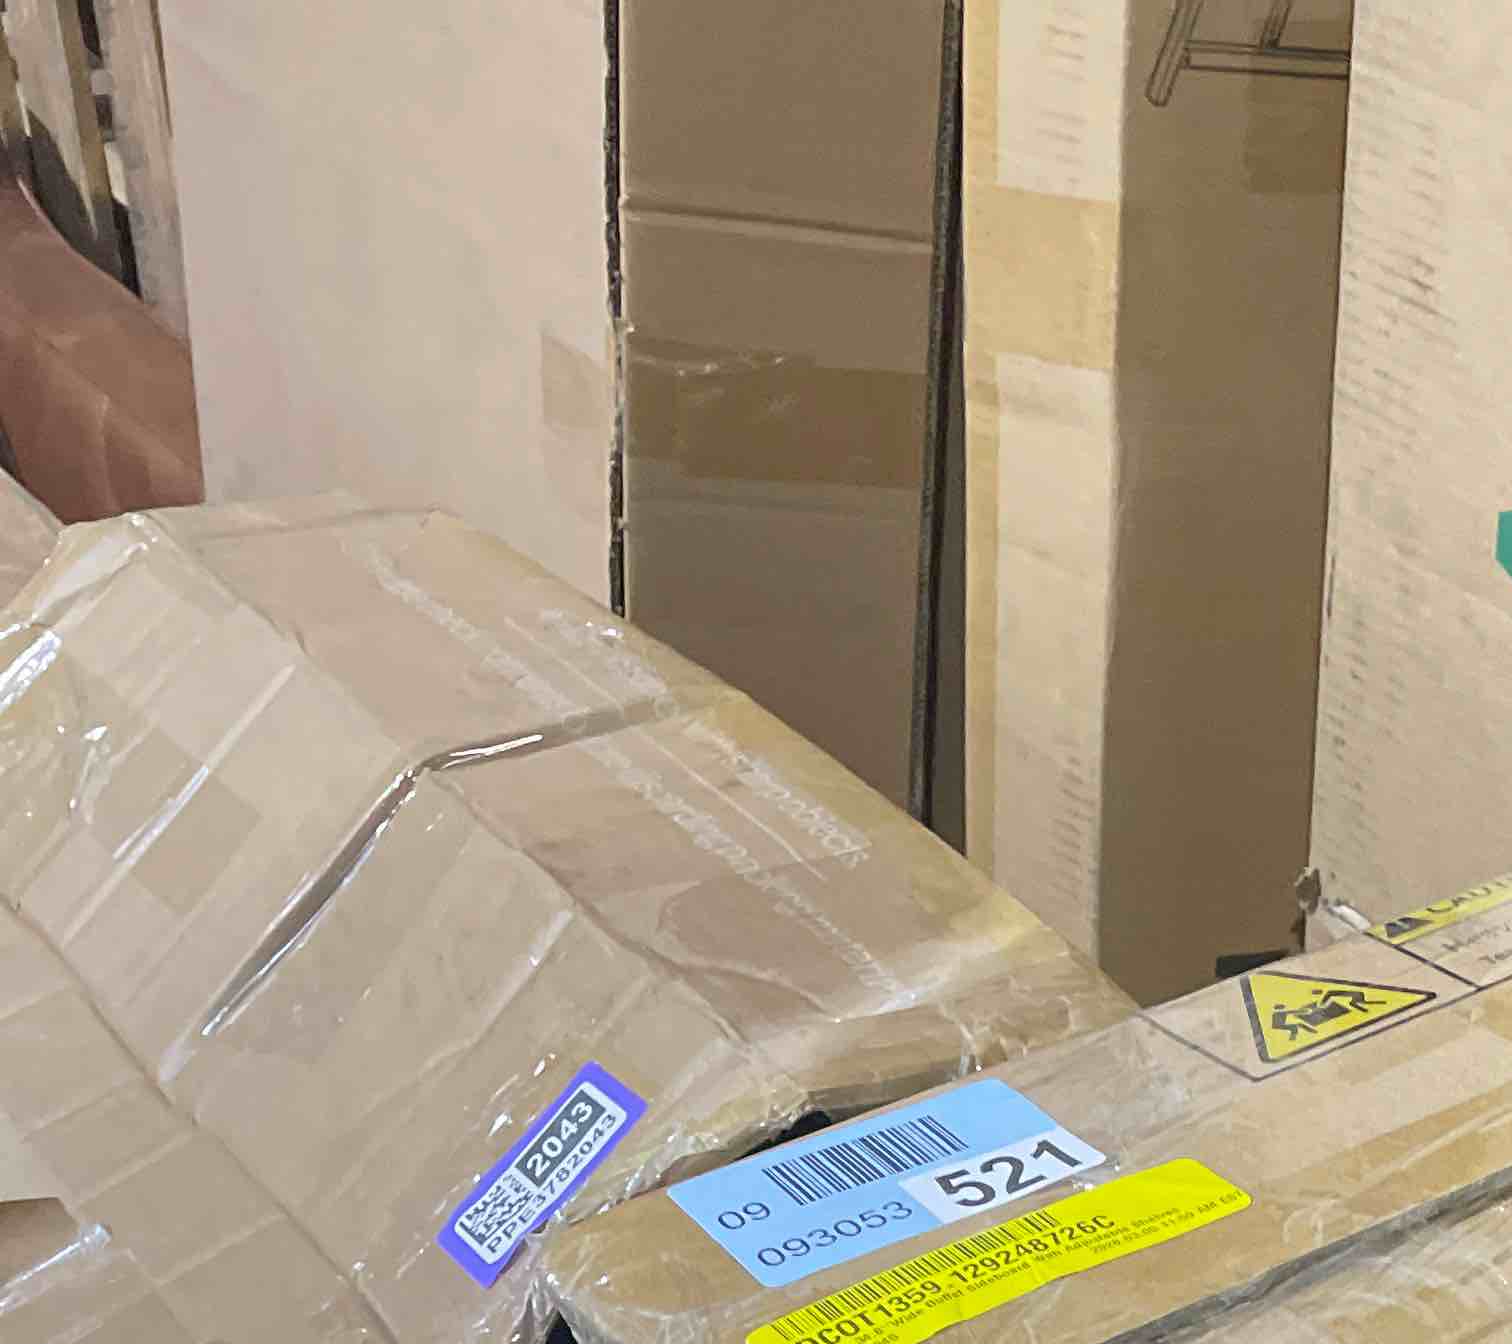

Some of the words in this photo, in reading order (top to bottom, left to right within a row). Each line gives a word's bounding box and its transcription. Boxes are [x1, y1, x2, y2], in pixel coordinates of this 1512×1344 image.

[526, 1101, 593, 1178] 2043
[938, 1138, 1084, 1207] 521
[488, 1113, 617, 1254] PPE3782043
[716, 1200, 771, 1232] 09
[757, 1201, 914, 1268] 093053
[950, 1213, 1116, 1285] 129248726C
